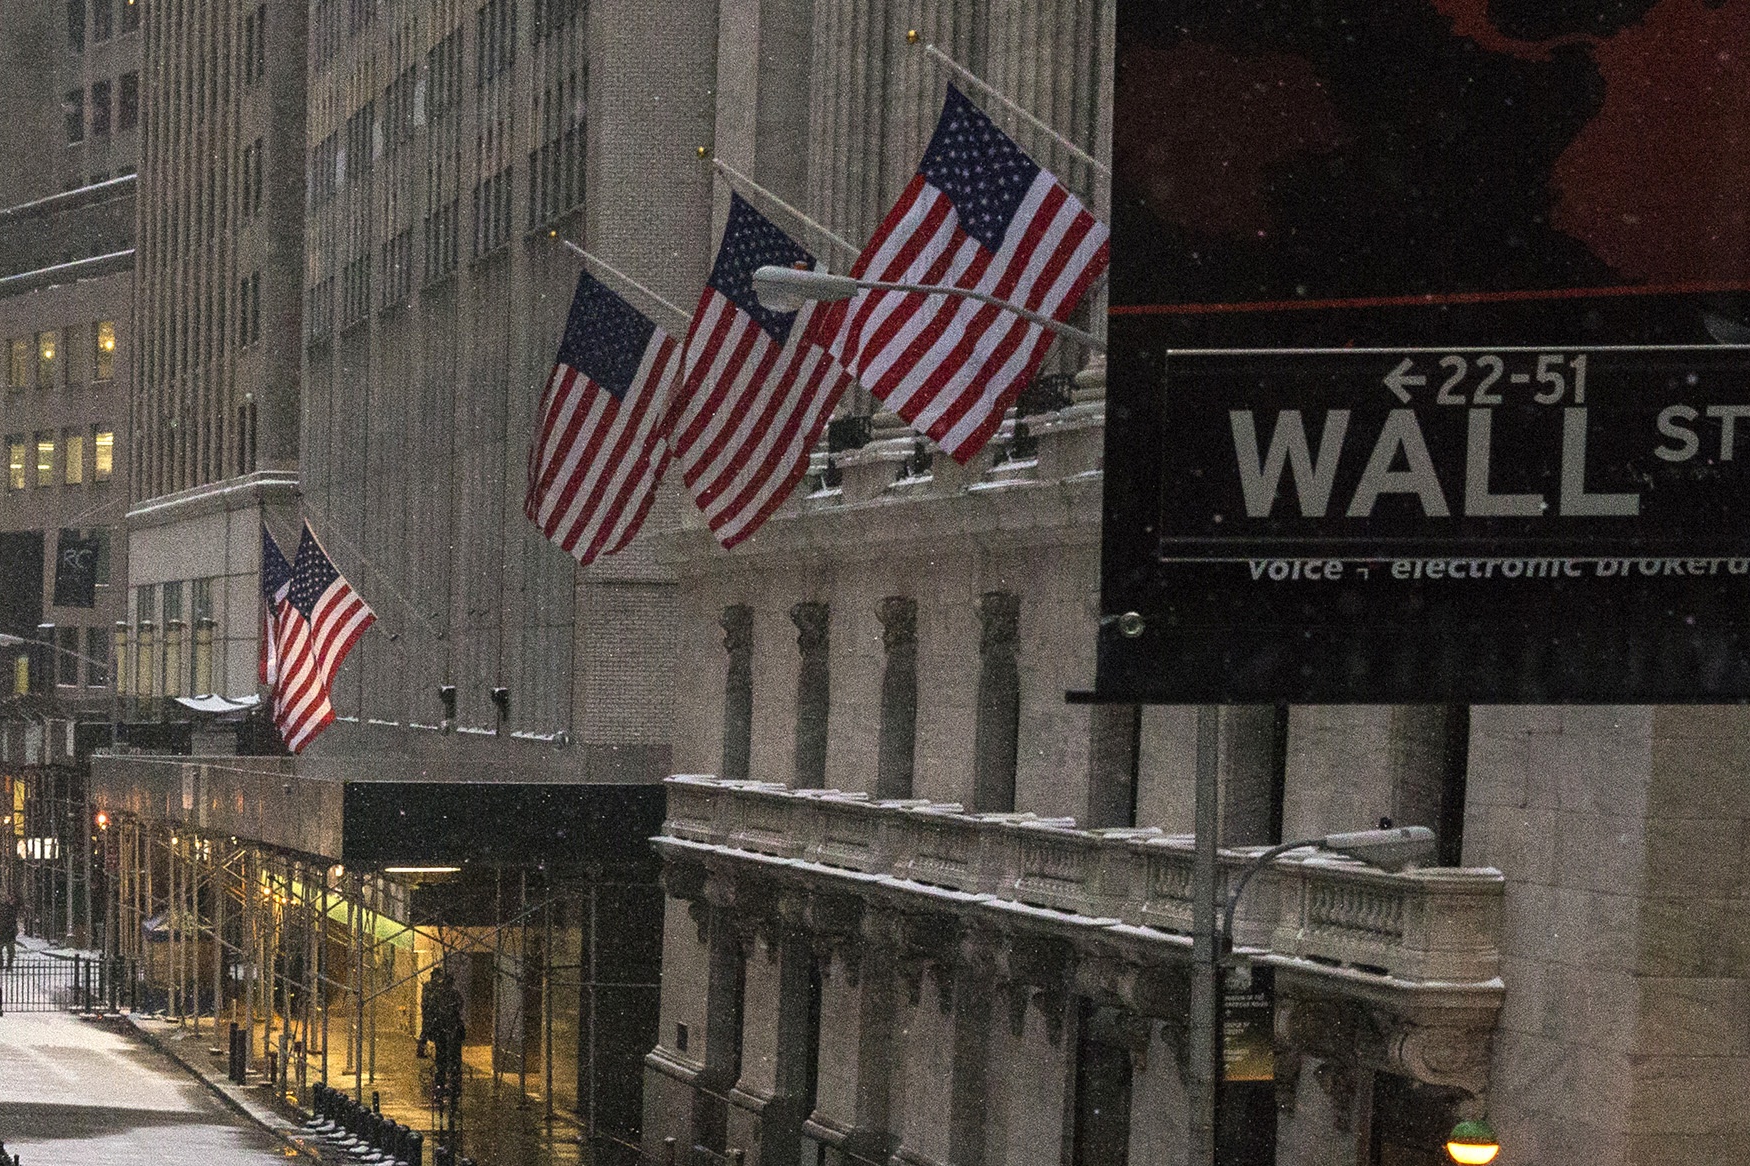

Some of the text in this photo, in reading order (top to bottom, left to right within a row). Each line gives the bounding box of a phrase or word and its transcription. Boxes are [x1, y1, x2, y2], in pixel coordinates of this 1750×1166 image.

[1437, 355, 1586, 404] 22-51
[1229, 404, 1750, 517] WALL ST
[1248, 560, 1344, 581] voice
[1391, 559, 1581, 580] electronic
